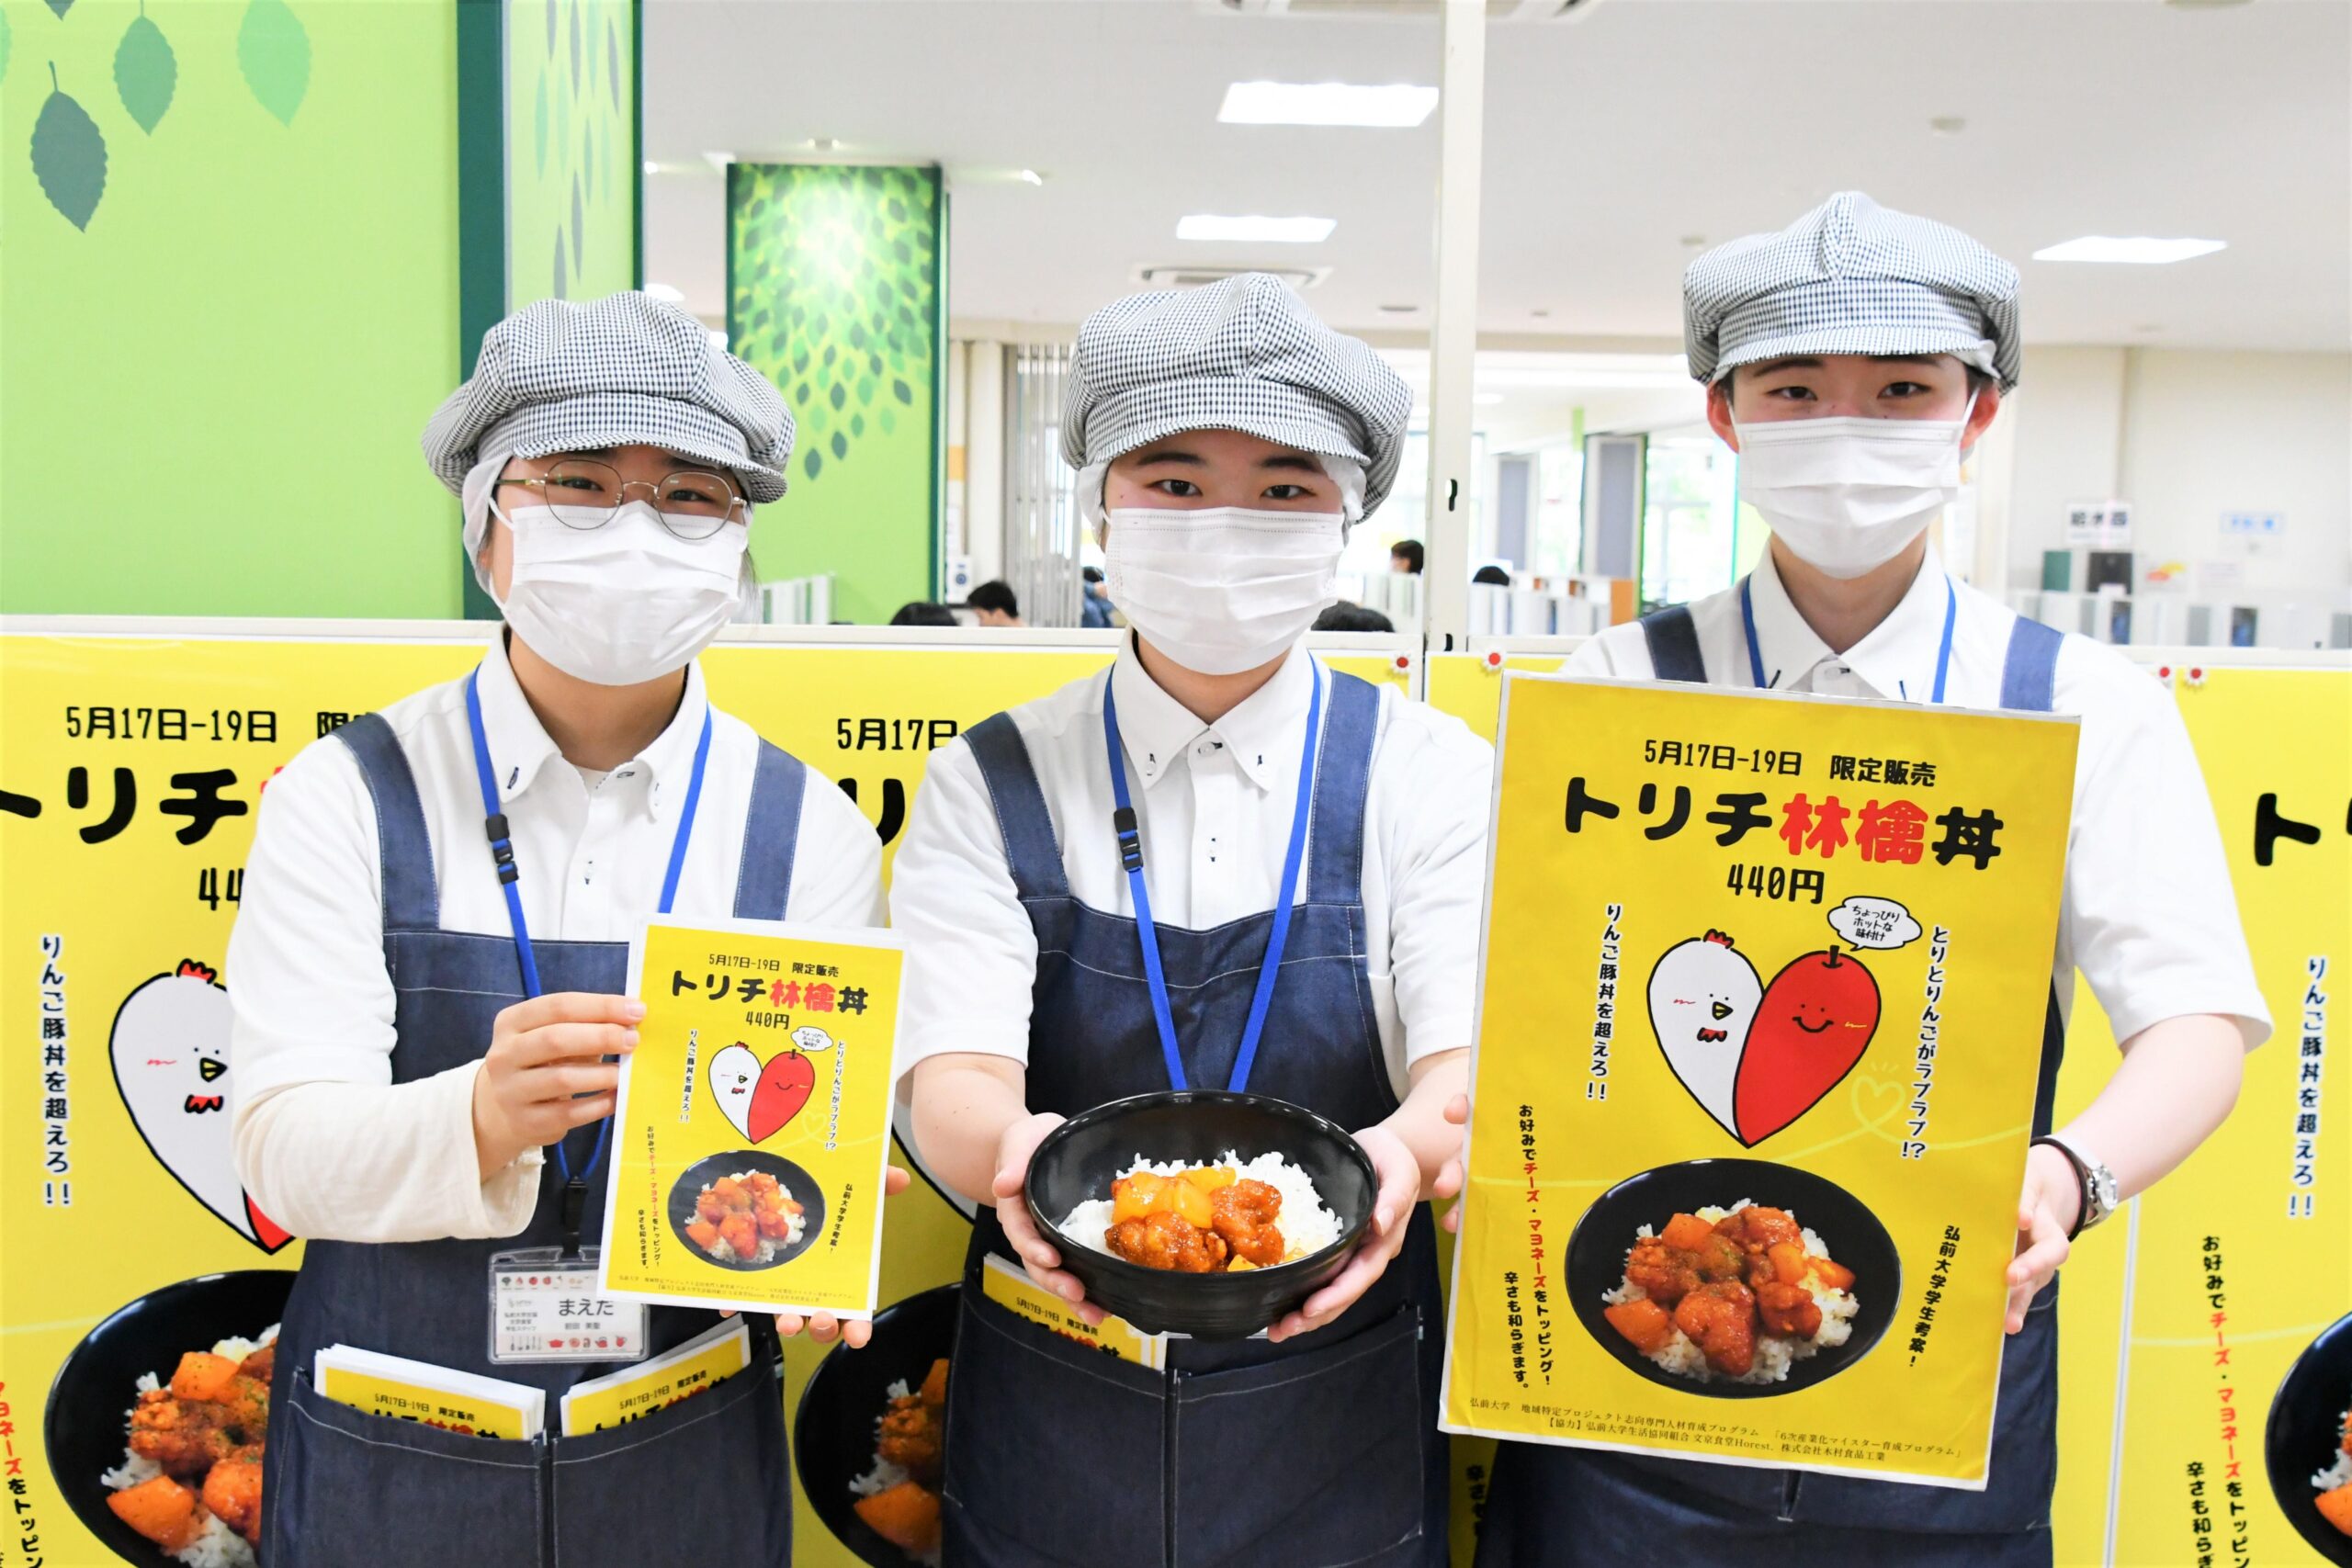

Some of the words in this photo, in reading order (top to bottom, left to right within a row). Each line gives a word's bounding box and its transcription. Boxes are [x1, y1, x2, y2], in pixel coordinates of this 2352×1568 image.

[1644, 739, 1803, 776] 5月17日-19日
[1829, 755, 1937, 787] 限定販売
[1564, 777, 2005, 871] トリチ林檎丼
[1726, 863, 1826, 904] 440円
[1853, 917, 1893, 932] ホットな
[1856, 928, 1886, 942] 味付け
[792, 962, 840, 978] 限定販売
[673, 970, 869, 1016] トリチ林檎丼
[745, 1010, 790, 1030] 440円
[1504, 1271, 1529, 1389] 辛さも和らぎます。
[1469, 1397, 1511, 1412] 弘前大学
